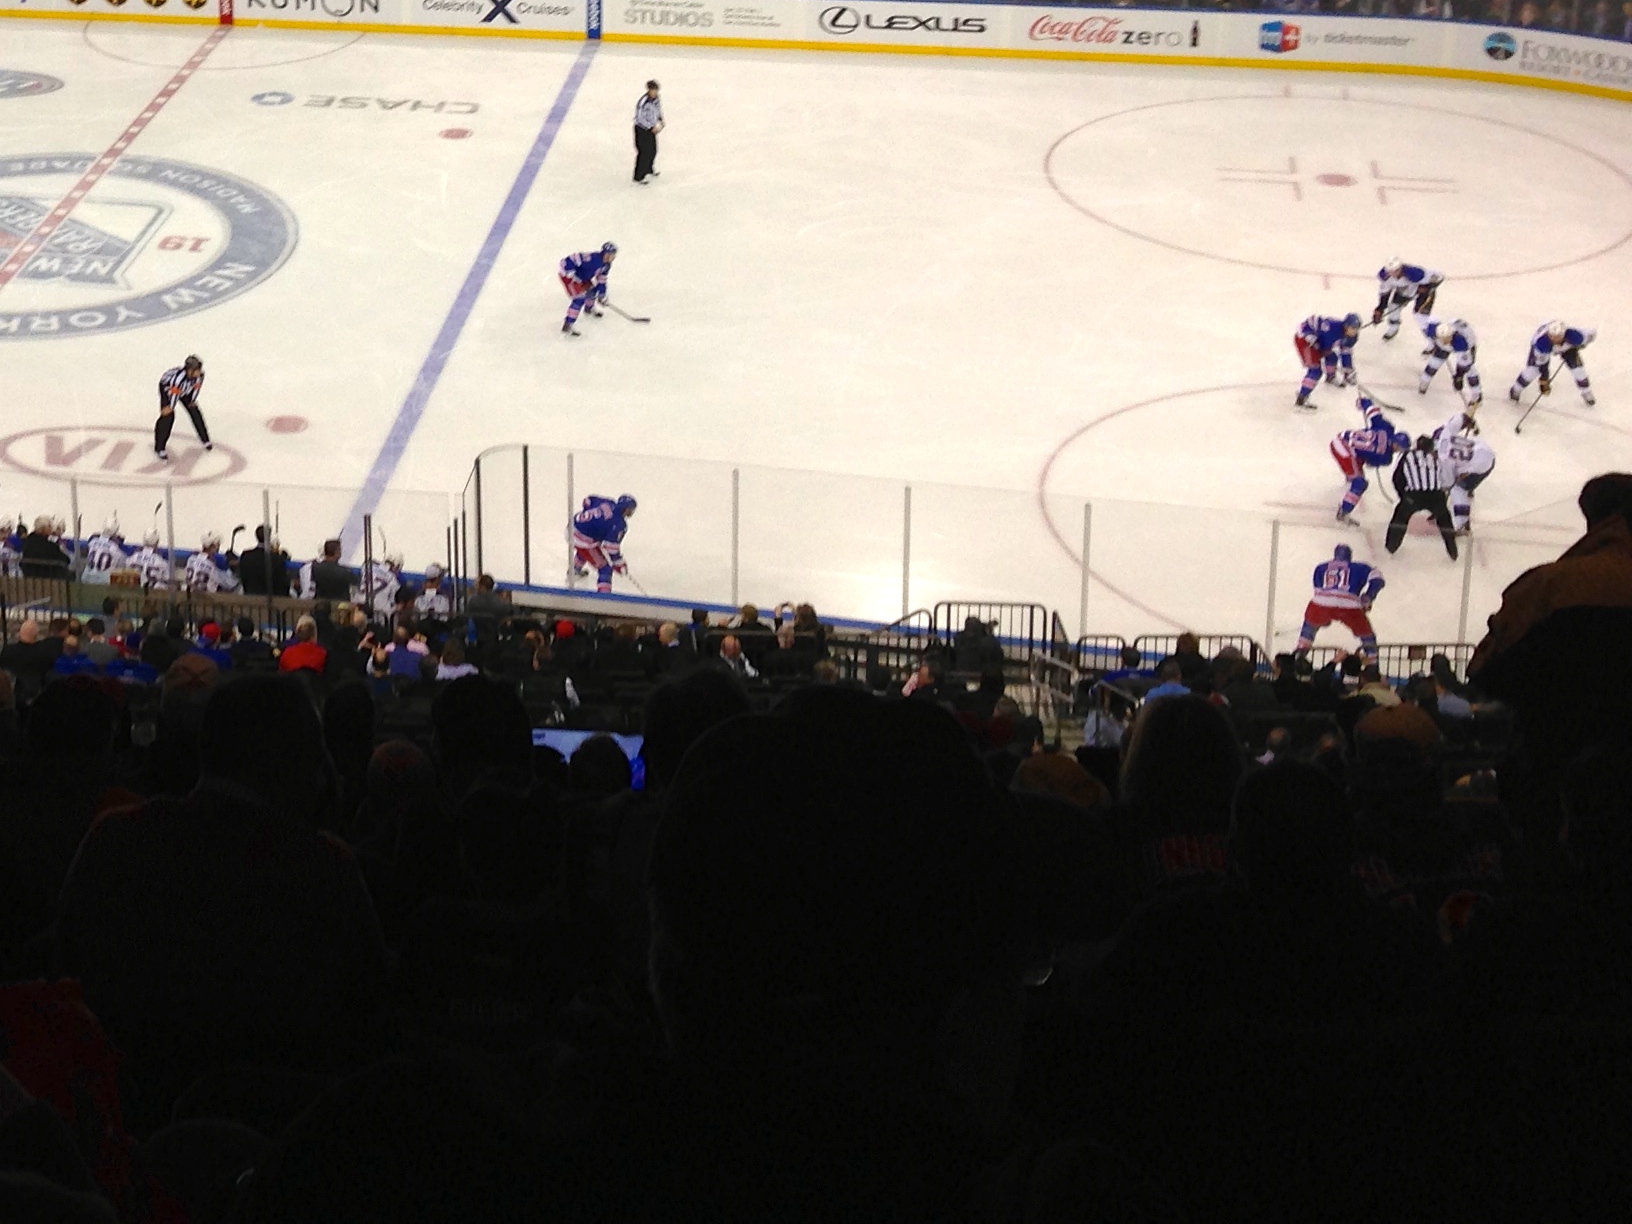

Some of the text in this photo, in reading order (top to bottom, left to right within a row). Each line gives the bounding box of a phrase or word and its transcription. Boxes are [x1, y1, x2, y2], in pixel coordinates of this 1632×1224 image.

[623, 6, 714, 29] STUDIOS
[865, 14, 987, 33] LEXUS
[1121, 29, 1183, 47] zero
[302, 93, 480, 114] CHASE
[157, 233, 210, 254] 19
[26, 254, 115, 278] NEW
[161, 258, 256, 314] NEW
[45, 434, 204, 477] KIA
